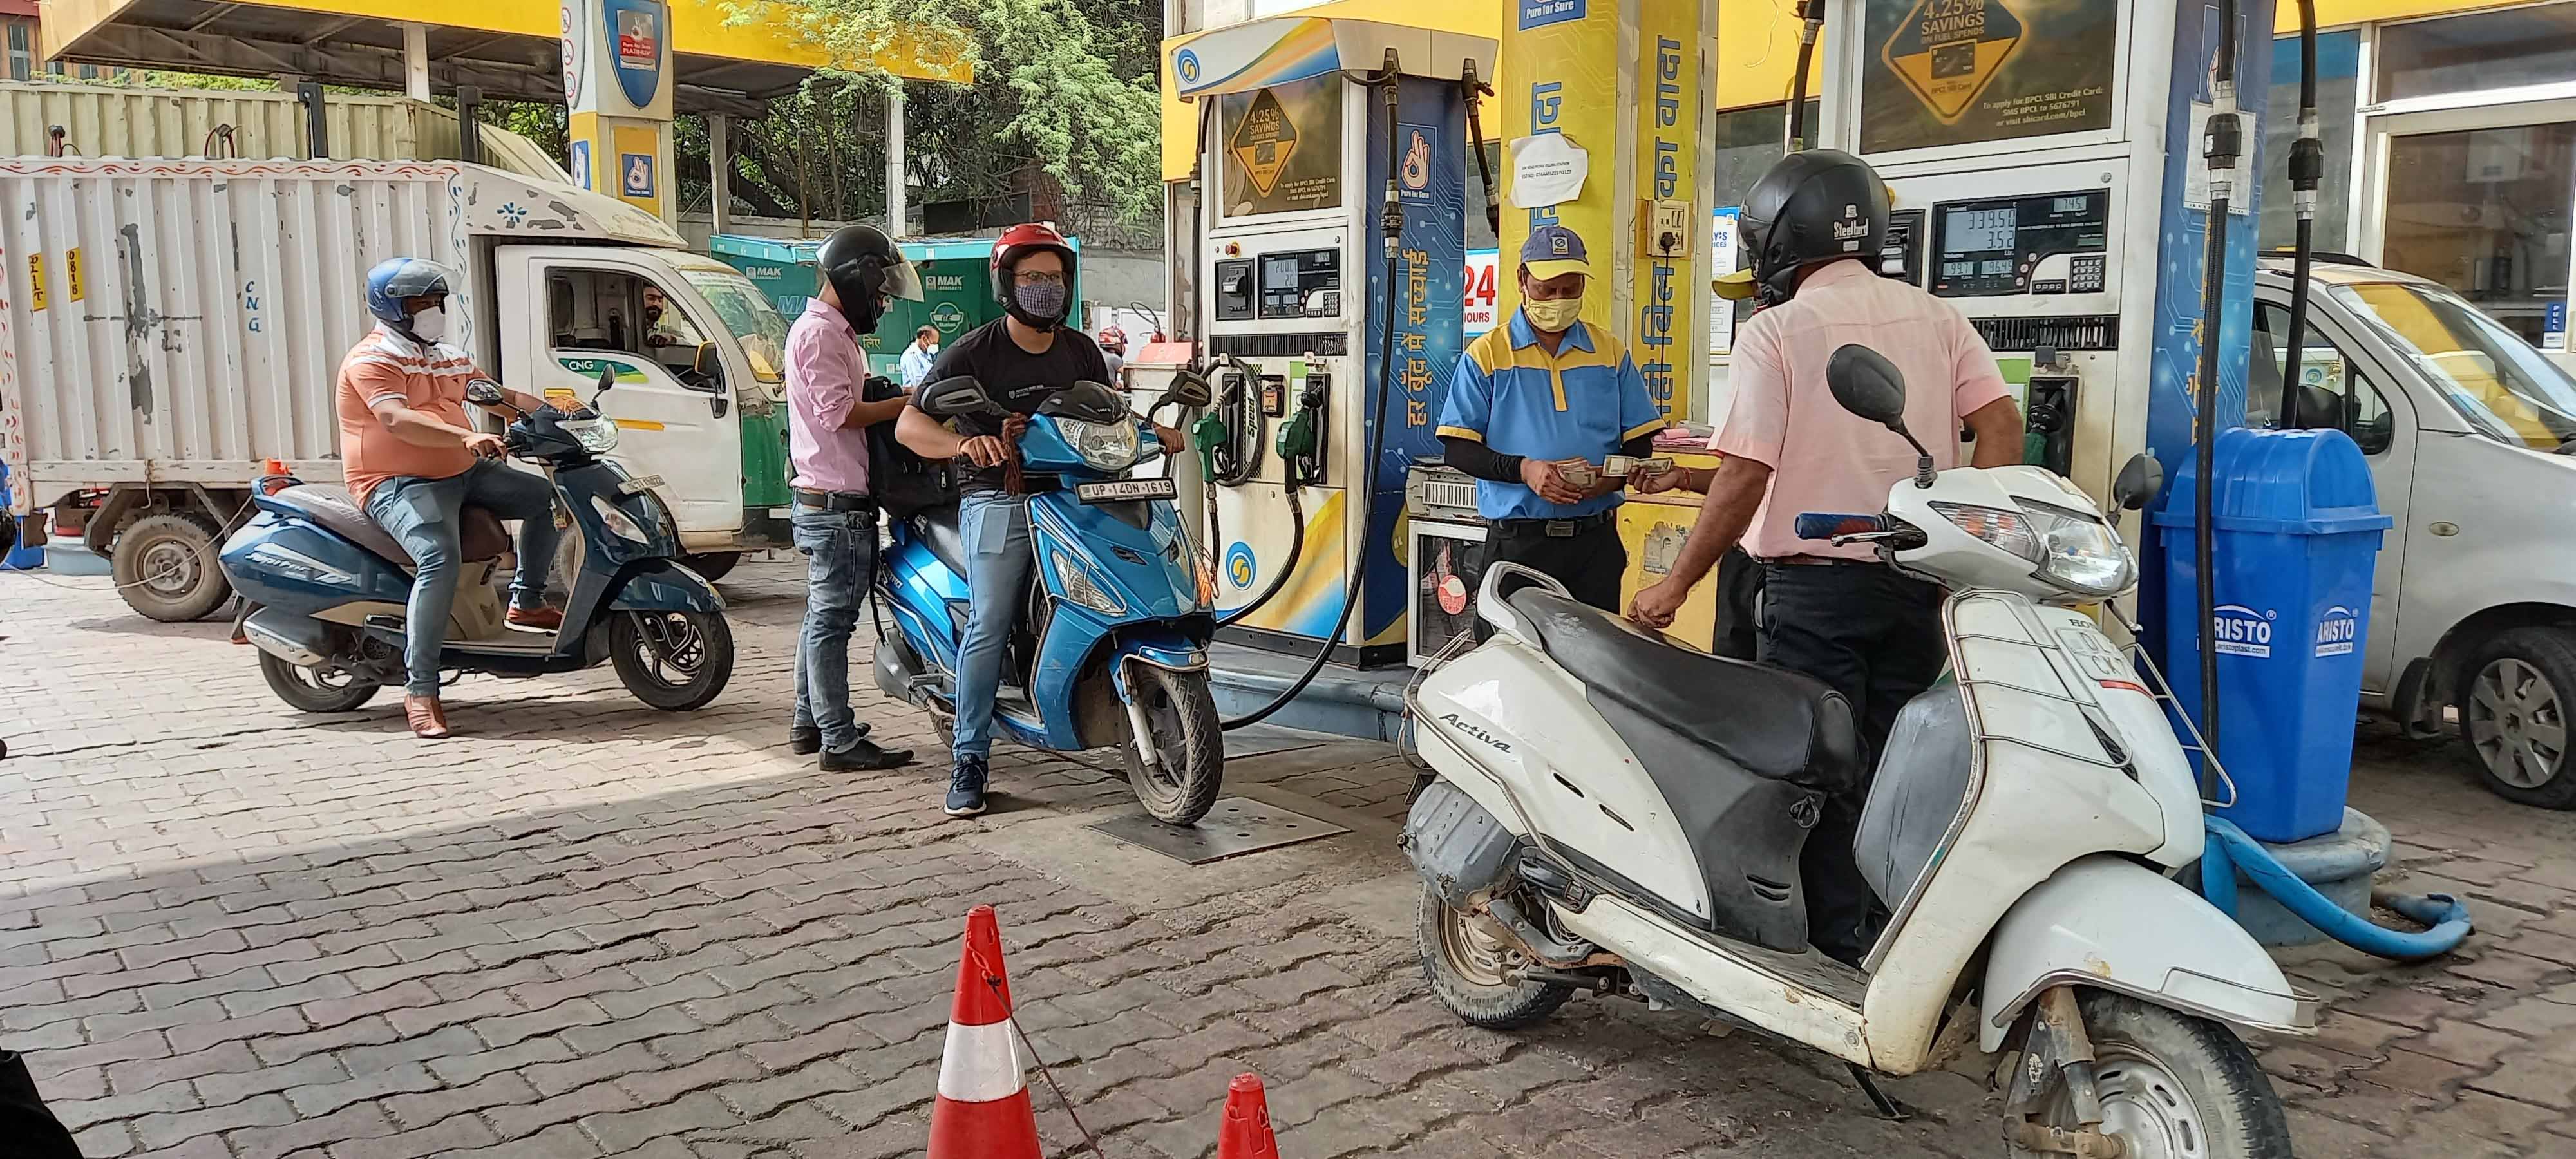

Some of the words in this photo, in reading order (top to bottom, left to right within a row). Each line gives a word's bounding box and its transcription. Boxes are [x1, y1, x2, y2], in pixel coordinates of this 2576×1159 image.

[1526, 8, 1541, 19] Pure
[1542, 4, 1554, 15] for
[1555, 1, 1574, 12] Sure
[1924, 0, 1984, 19] 4.25%
[1921, 12, 1984, 35] SAVINGS
[1933, 32, 1951, 42] FUEL
[1953, 26, 1984, 39] SPENDS
[1655, 35, 1680, 129] वादा
[1993, 100, 2011, 110] apply
[2025, 95, 2043, 104] BPCL
[2058, 90, 2081, 99] Credit
[1249, 108, 1280, 124] 4.25%
[2002, 108, 2019, 117] SMS
[2020, 106, 2038, 114] BPCL
[2005, 117, 2021, 126] visit
[2022, 108, 2086, 124] sbicard.com/bpcl
[1249, 120, 1280, 135] SAVINGS
[1654, 136, 1678, 200] का
[69, 250, 78, 295] 0816
[757, 267, 782, 276] MAK
[937, 276, 963, 286] MAK
[1402, 248, 1429, 327] सच्चाई
[1464, 265, 1496, 306] 24
[245, 280, 261, 333] CNG
[1641, 261, 1675, 350] बिल
[1401, 332, 1426, 352] में
[569, 361, 594, 370] CNG
[1401, 357, 1433, 394] बूँद
[1247, 397, 1258, 438] Speed
[1407, 399, 1428, 429] हर
[1092, 485, 1106, 496] UP
[1145, 482, 1171, 493] 1619
[2214, 617, 2271, 644] RISTO
[2317, 618, 2354, 643] ARISTO
[2215, 645, 2266, 655] .aristoplast.com
[1438, 713, 1511, 753] Activa
